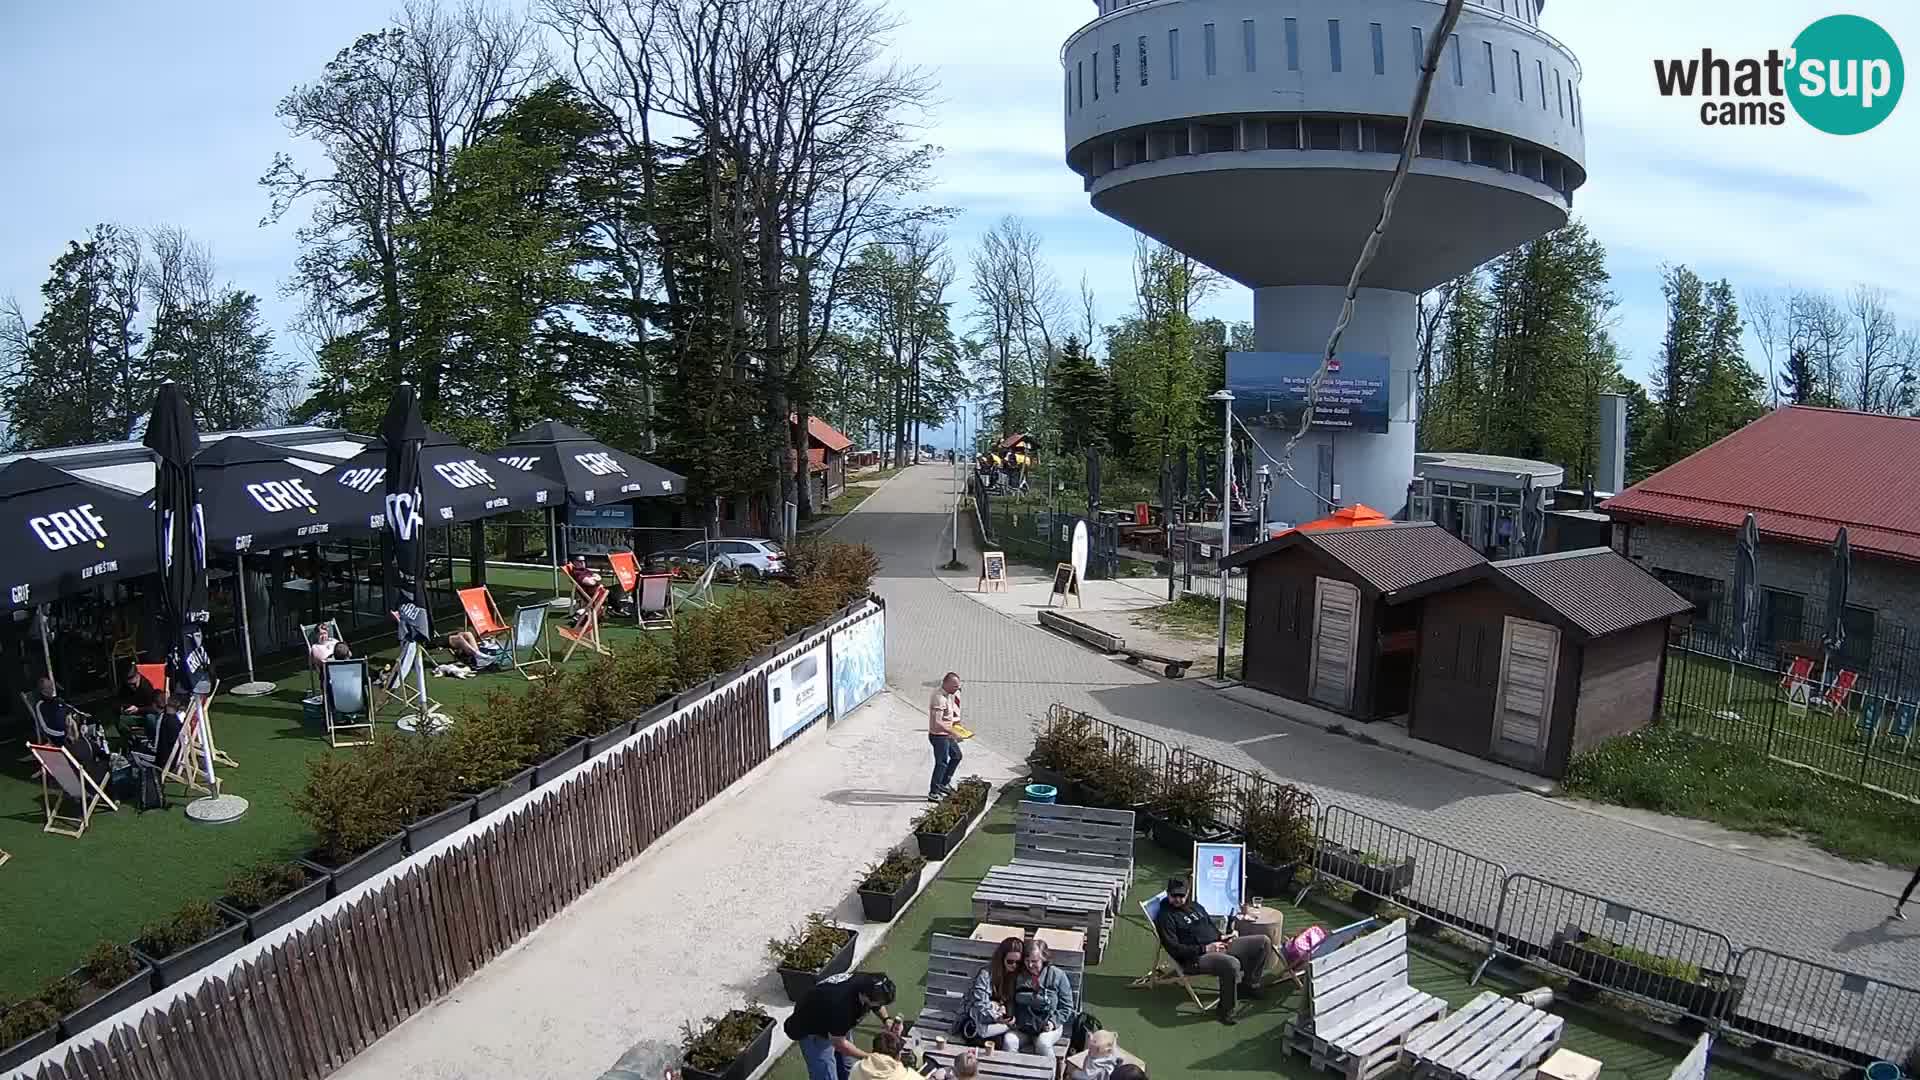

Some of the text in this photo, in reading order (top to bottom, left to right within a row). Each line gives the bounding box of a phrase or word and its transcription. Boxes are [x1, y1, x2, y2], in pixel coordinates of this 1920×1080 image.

[434, 460, 495, 488] GRIF
[247, 478, 319, 513] GRIF
[30, 503, 108, 551] GRIF
[12, 583, 30, 604] GRIF
